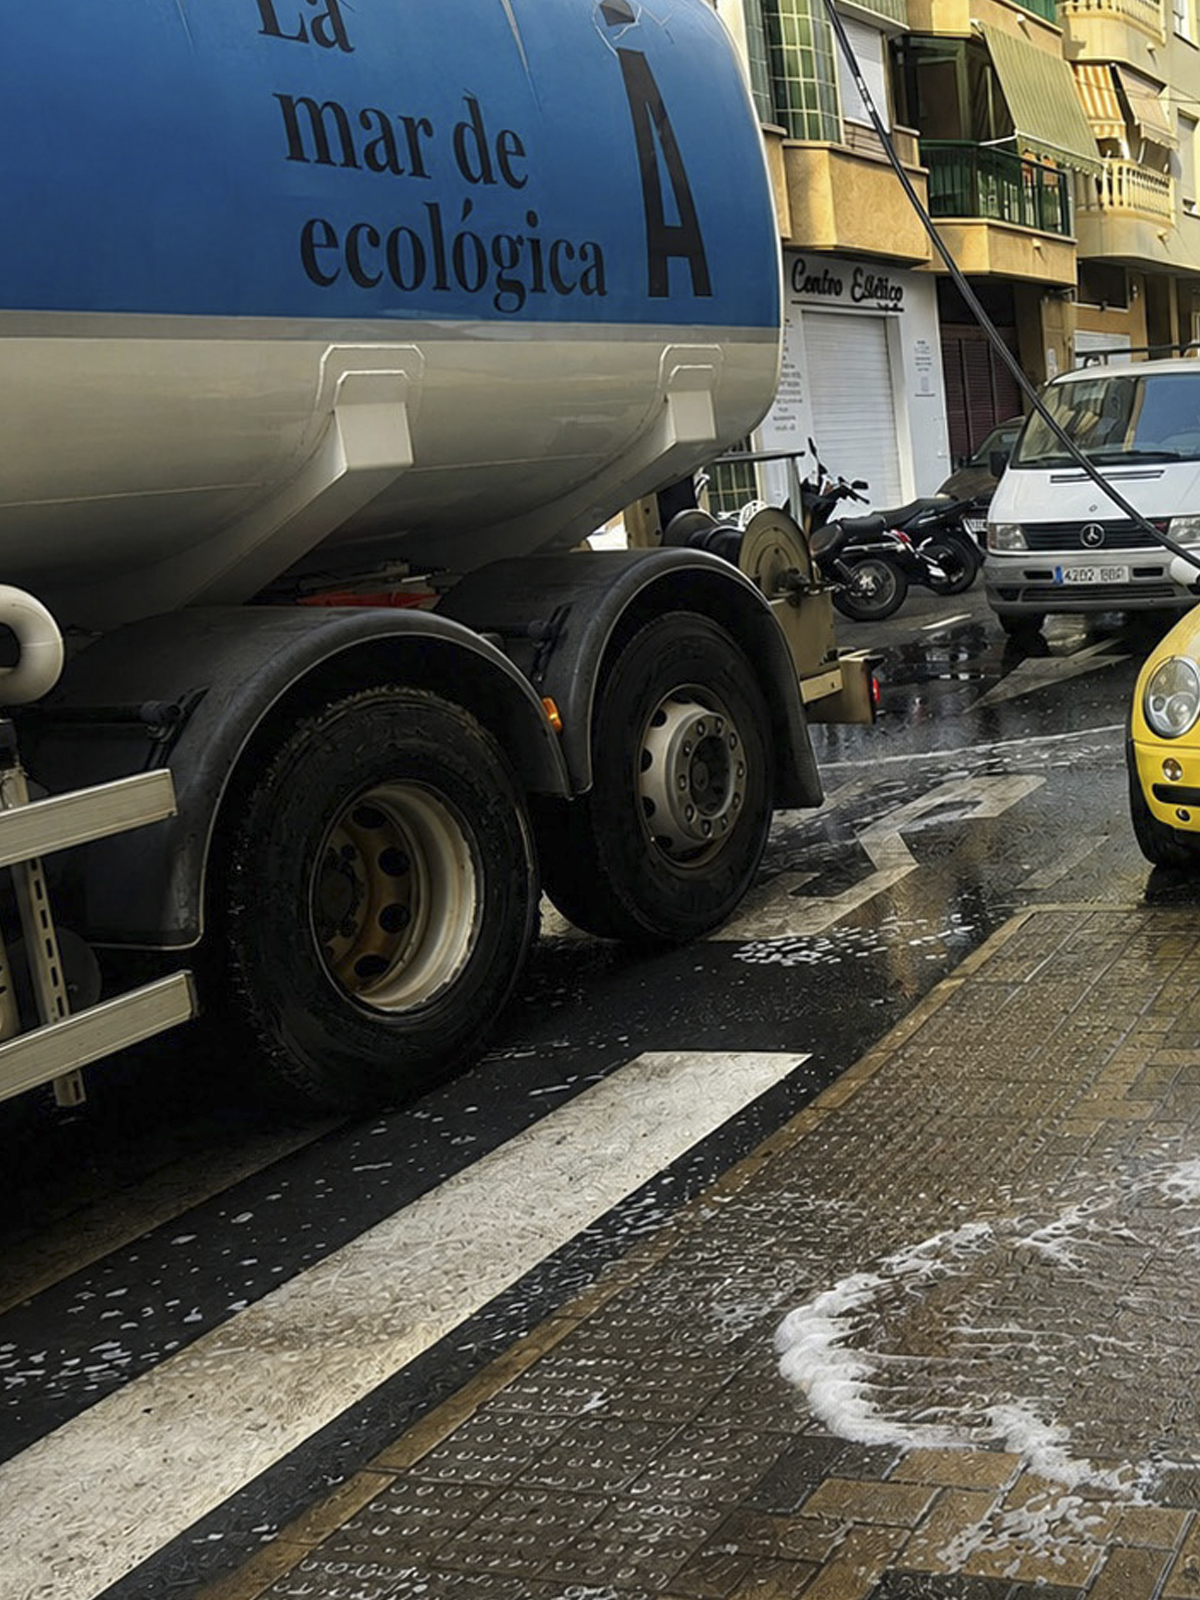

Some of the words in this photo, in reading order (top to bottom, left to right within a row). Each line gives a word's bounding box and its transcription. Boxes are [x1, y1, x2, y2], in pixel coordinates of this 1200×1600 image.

[258, 0, 355, 53] La
[273, 92, 433, 180] mar
[452, 89, 529, 189] de
[300, 200, 608, 313] ecológica
[791, 258, 843, 297] Centro
